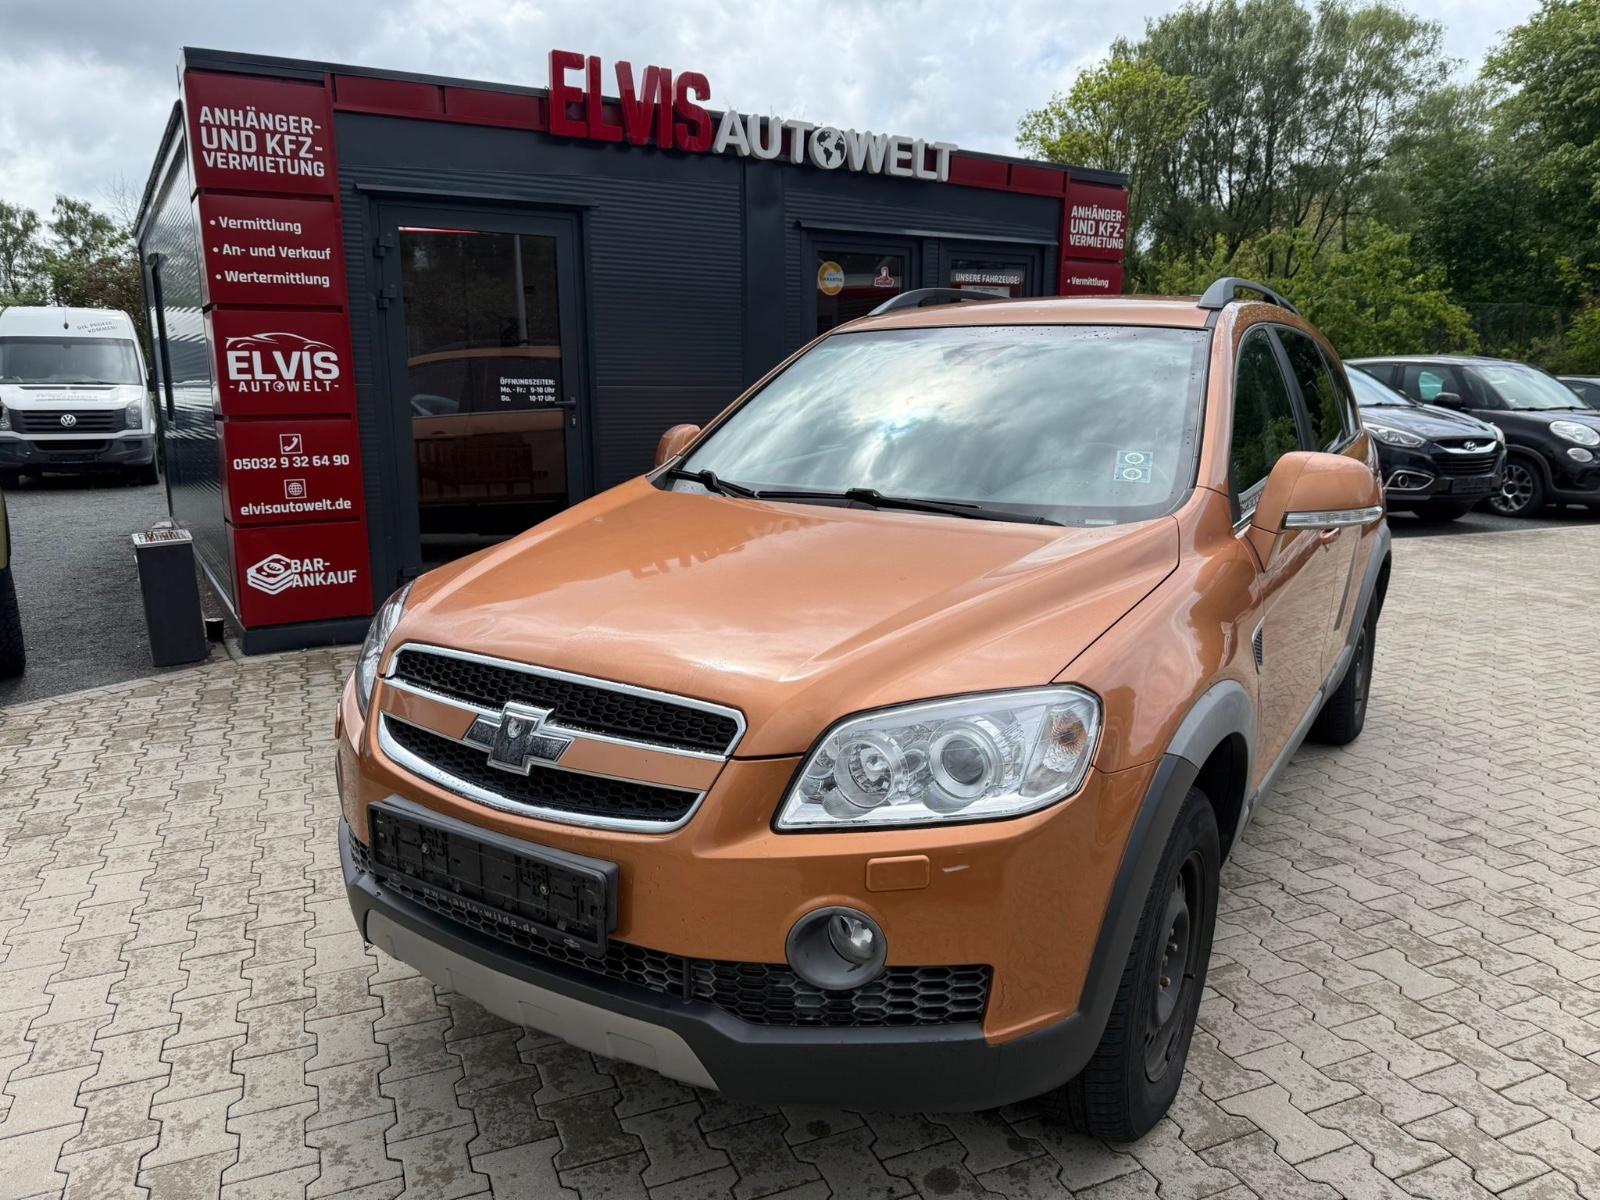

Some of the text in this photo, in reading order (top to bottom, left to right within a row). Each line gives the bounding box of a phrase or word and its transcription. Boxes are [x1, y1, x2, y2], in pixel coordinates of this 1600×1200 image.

[548, 49, 712, 153] ELVIS
[200, 106, 321, 135] ANHÄNGER-
[201, 126, 323, 158] UND KFZ-
[202, 151, 325, 177] VERMIETUNG
[1071, 205, 1125, 221] ANHÄNGER-
[218, 216, 302, 234] Vermittlung
[1070, 219, 1124, 237] UND KFZ-
[1070, 235, 1124, 249] VERMIETUNG
[222, 244, 331, 260] An- und Verkauf
[225, 270, 330, 288] Wertermittlung
[955, 273, 1020, 284] UNSERE FAHRZEUGE:
[1071, 277, 1109, 288] Vermittlung
[226, 350, 340, 381] ELVIS
[500, 376, 555, 385] ÖFFNUNGSZEITEN:
[233, 454, 350, 470] 05032 9 32 64 90
[240, 498, 352, 516] elvisautowelt.de
[290, 558, 331, 573] BAR-
[292, 570, 357, 588] ANKAUF
[422, 886, 537, 935] www.auto-wilde.de
